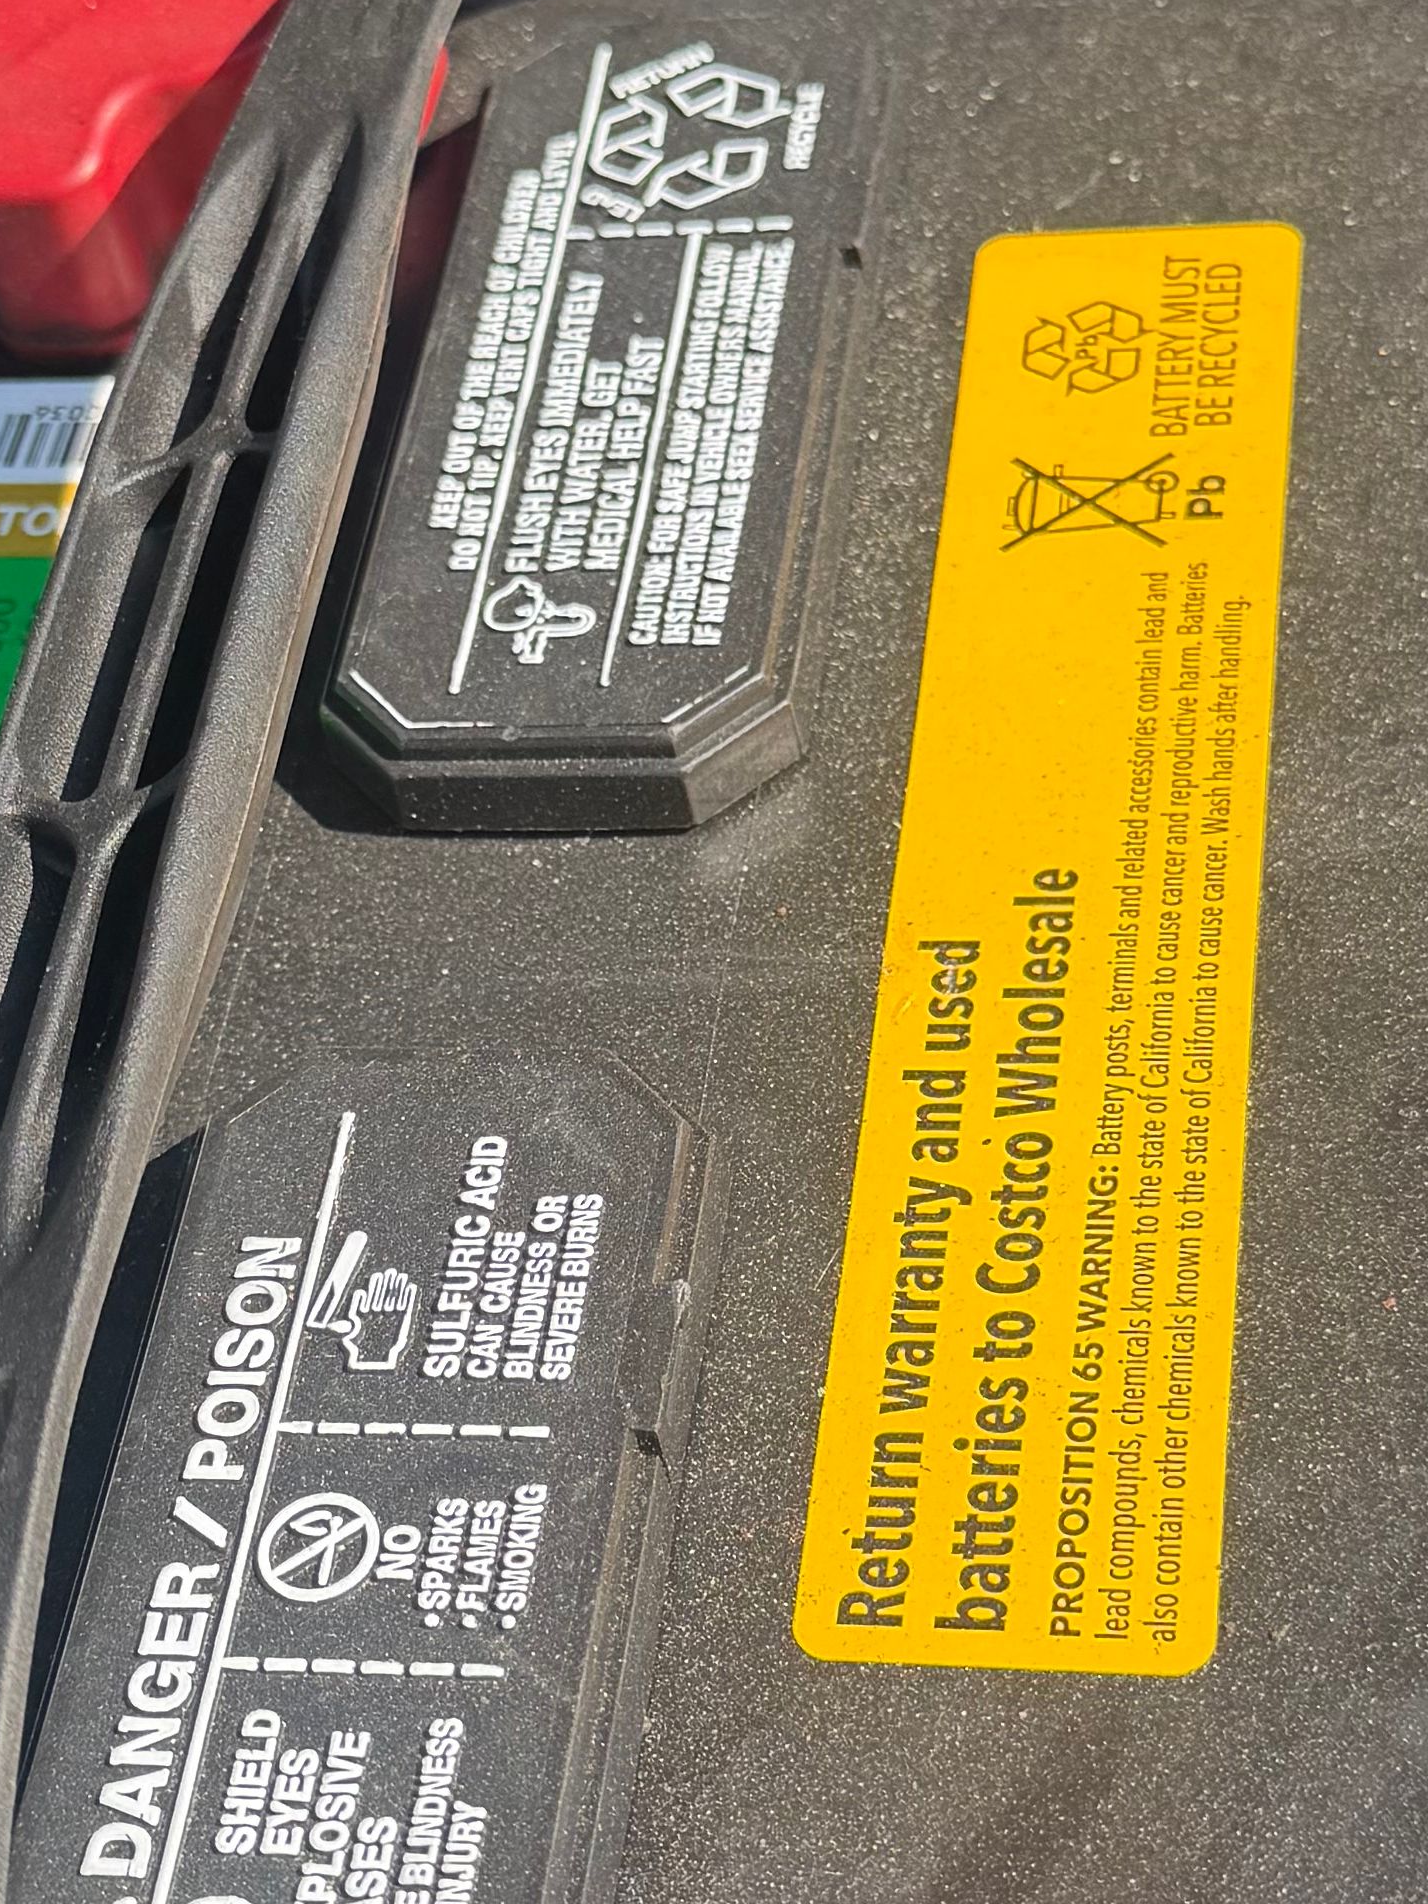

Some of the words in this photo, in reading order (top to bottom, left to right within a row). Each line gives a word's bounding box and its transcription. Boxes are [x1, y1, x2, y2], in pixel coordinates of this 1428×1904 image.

[782, 82, 824, 170] RECYCLE
[693, 243, 731, 318] FOLLOW
[1159, 254, 1201, 323] MUST
[538, 274, 603, 426] IMMEDIATELY
[1074, 333, 1102, 360] Pb
[1196, 263, 1242, 388] RECYCLED
[581, 359, 622, 406] GET
[621, 335, 664, 395] FAST
[676, 319, 718, 409] STARTING
[708, 325, 747, 403] OWNERS
[733, 354, 772, 430] SERVICE
[1148, 331, 1195, 437] BATTERY
[606, 396, 651, 459] HELP
[666, 409, 701, 463] JUMP
[693, 406, 733, 482] VEHICLE
[1193, 395, 1233, 426] BE
[523, 428, 569, 490] EYES
[559, 409, 613, 503] WATER.
[656, 463, 692, 513] SAFE
[724, 431, 759, 480] SEEK
[584, 461, 638, 569] MEDICAL
[689, 482, 718, 505] IN
[1185, 474, 1225, 518] Pb
[504, 492, 553, 572] FLUSH
[545, 505, 591, 571] WITH
[646, 514, 682, 552] FOR
[704, 481, 750, 581] AVAILABLE
[660, 507, 714, 643] INSTRUCTIONS
[695, 582, 730, 622] NOT
[1147, 573, 1167, 598] and
[1177, 563, 1207, 634] Batteries
[692, 624, 722, 645] IF
[1136, 607, 1164, 642] lead
[1210, 596, 1250, 678] handling.
[1137, 650, 1160, 711] contain
[1172, 641, 1201, 690] harm.
[1207, 683, 1237, 722] after
[1127, 717, 1156, 812] accessories
[1167, 696, 1199, 805] reproductive
[1203, 728, 1235, 780] hands
[1162, 812, 1189, 844] and
[1200, 787, 1230, 834] Wash
[1115, 819, 1148, 879] related
[1161, 849, 1186, 906] cancer
[1202, 840, 1227, 901] cancer.
[1113, 885, 1142, 918] and
[1156, 910, 1181, 961] cause
[1198, 906, 1223, 956] cause
[917, 940, 980, 1051] used
[993, 868, 1078, 1118] Wholesale
[1105, 923, 1139, 1012] terminals
[1149, 966, 1176, 985] to
[1191, 962, 1219, 980] to
[1103, 1018, 1135, 1077] posts,
[1139, 991, 1174, 1088] California
[1182, 986, 1217, 1083] California
[901, 1069, 966, 1162] and
[1089, 1083, 1134, 1158] Battery
[1138, 1093, 1167, 1113] of
[1180, 1088, 1211, 1108] of
[1136, 1119, 1166, 1169] state
[1179, 1115, 1209, 1164] state
[974, 1131, 1053, 1293] Costco
[1130, 1174, 1162, 1209] the
[1174, 1170, 1206, 1204] the
[1174, 1210, 1204, 1230] to
[422, 1214, 490, 1378] SULFURIC
[458, 1135, 508, 1210] ACID
[560, 1193, 603, 1276] BURNS
[1075, 1165, 1119, 1333] WARNING:
[1130, 1214, 1159, 1235] to
[479, 1230, 525, 1313] CAUSE
[504, 1241, 557, 1379] BLINDNESS
[531, 1194, 568, 1232] OR
[876, 1176, 972, 1414] warranty
[1120, 1242, 1157, 1313] known
[1166, 1237, 1202, 1307] known
[182, 1236, 302, 1480] POISON
[466, 1323, 504, 1378] CAN
[539, 1281, 587, 1380] SEVERE
[972, 1310, 1035, 1362] to
[1071, 1342, 1104, 1381] 65
[1112, 1318, 1154, 1424] chemicals
[1159, 1314, 1196, 1420] chemicals
[1156, 1426, 1188, 1488] other
[173, 1495, 227, 1547] /
[836, 1431, 930, 1626] Return
[933, 1376, 1028, 1631] batteries
[1048, 1391, 1100, 1636] PROPOSITION
[1108, 1432, 1147, 1579] compounds,
[374, 1524, 421, 1580] NO
[417, 1497, 469, 1609] SPARKS
[455, 1499, 506, 1612] FLAMES
[494, 1483, 547, 1611] SMOKING
[1153, 1497, 1184, 1585] contain
[1093, 1587, 1131, 1639] lead
[1145, 1593, 1178, 1641] also
[79, 1561, 220, 1878] DANGER
[214, 1708, 280, 1854] SHIELD
[267, 1748, 319, 1855] EYES
[397, 1717, 463, 1886] BLINDNESS
